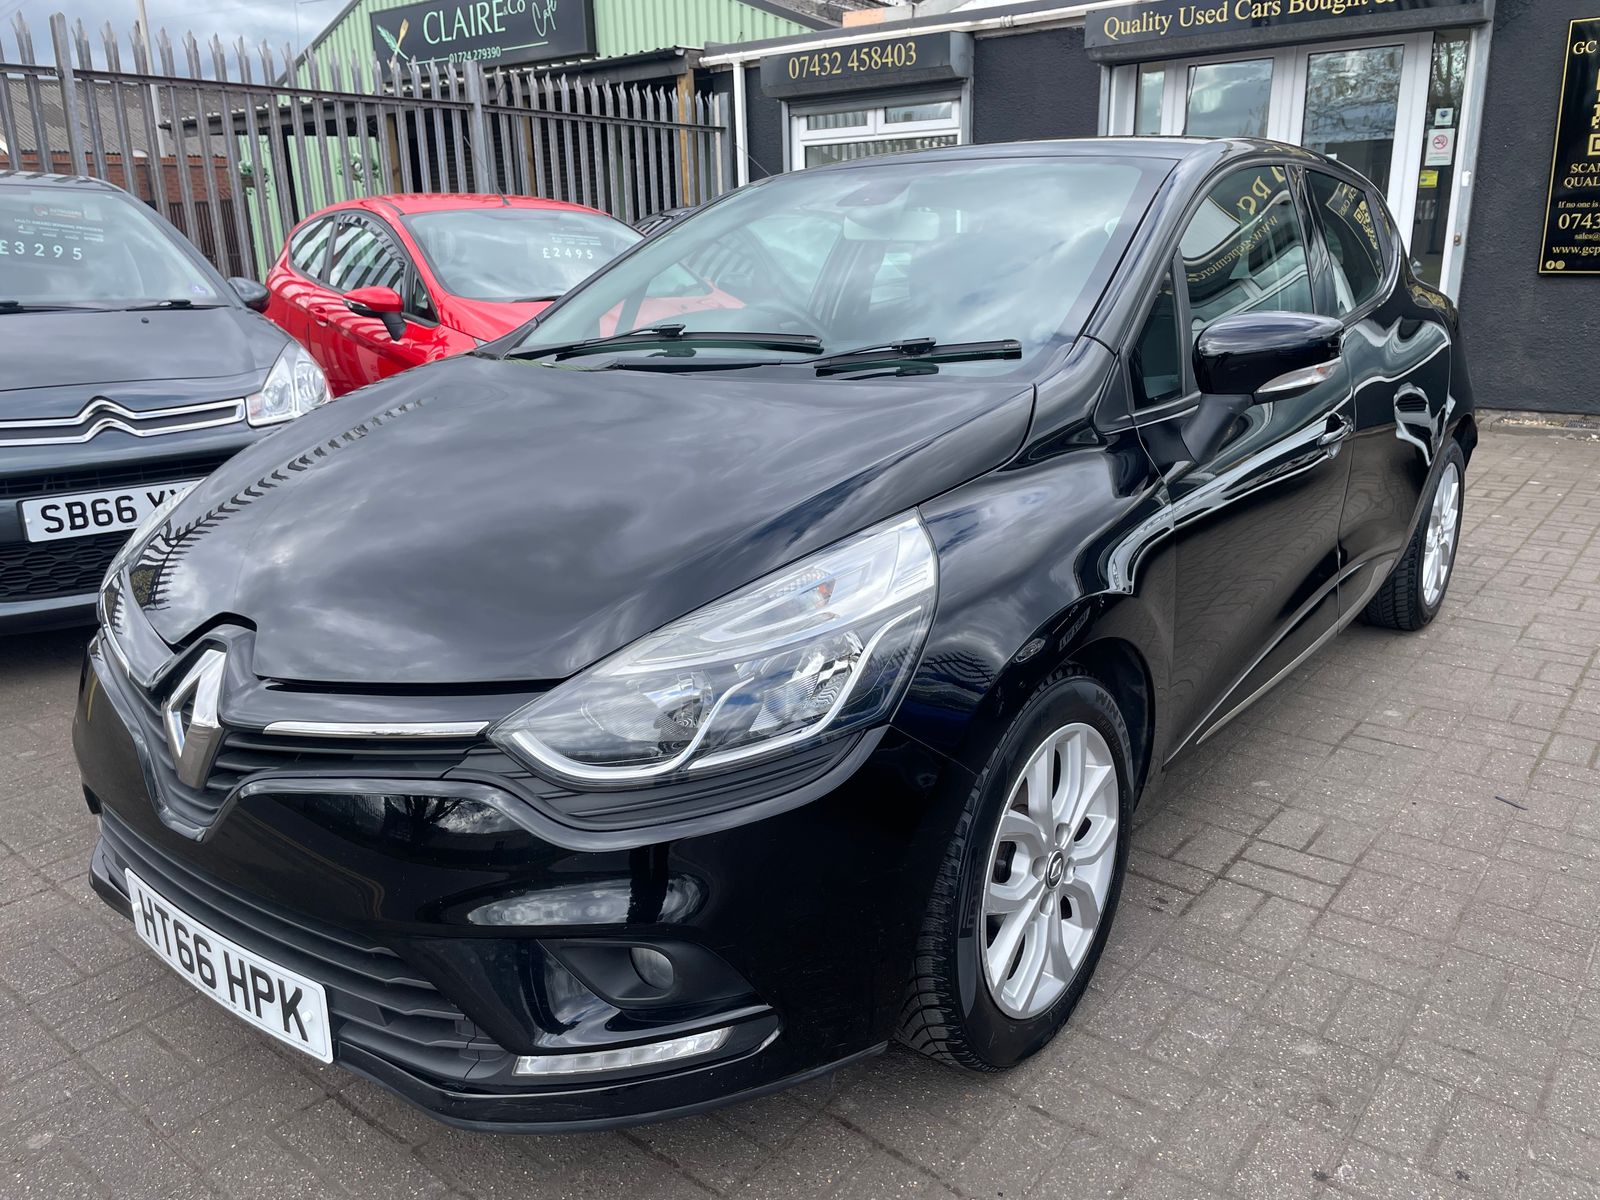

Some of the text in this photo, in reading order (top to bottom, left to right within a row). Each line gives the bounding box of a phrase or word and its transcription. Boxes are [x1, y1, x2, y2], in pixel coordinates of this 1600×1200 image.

[423, 0, 506, 45] CLAIRE
[1103, 11, 1173, 41] Quality
[1178, 1, 1228, 27] Used
[1234, 0, 1281, 20] Cars
[472, 46, 501, 61] 279390
[788, 42, 917, 79] 07432 458403
[1573, 40, 1597, 55] GC
[1558, 201, 1567, 209] If
[542, 247, 593, 260] £2495
[41, 495, 137, 533] SB66
[138, 888, 309, 1043] HT66 HPK
